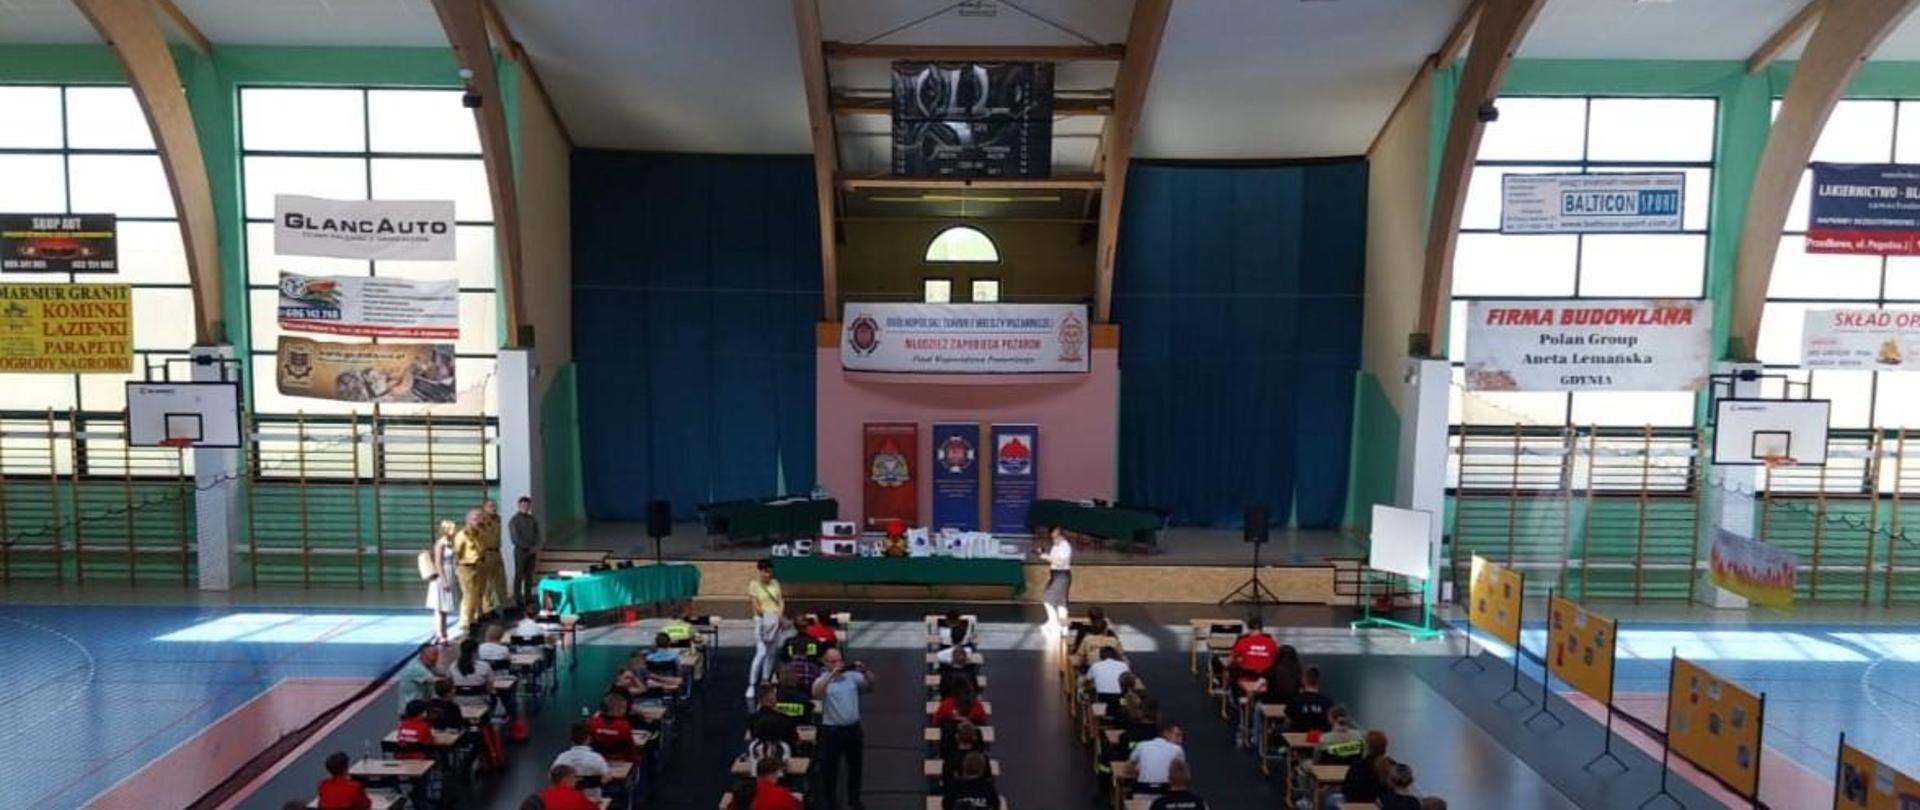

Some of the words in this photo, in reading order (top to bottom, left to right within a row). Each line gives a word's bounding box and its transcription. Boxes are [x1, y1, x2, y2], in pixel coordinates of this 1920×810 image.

[1819, 184, 1898, 198] LAKIERNICTWO
[1565, 195, 1636, 212] BALTICON
[1641, 192, 1676, 213] SPORT
[32, 218, 60, 230] SKUP
[62, 218, 81, 230] AUT
[68, 286, 127, 300] GRANIT
[43, 303, 128, 318] KOMINKI
[1487, 308, 1554, 326] FIRMA
[1560, 306, 1693, 326] BUDOWLANA
[1834, 312, 1891, 327] SKŁAD
[1539, 333, 1585, 346] Polan
[1588, 333, 1639, 348] Group
[43, 341, 127, 355] PARAPETY
[60, 357, 130, 370] NAGROBKI
[1522, 352, 1567, 365] Aneta
[1572, 352, 1653, 365] Lemańska
[1560, 374, 1613, 386] GDYNIA
